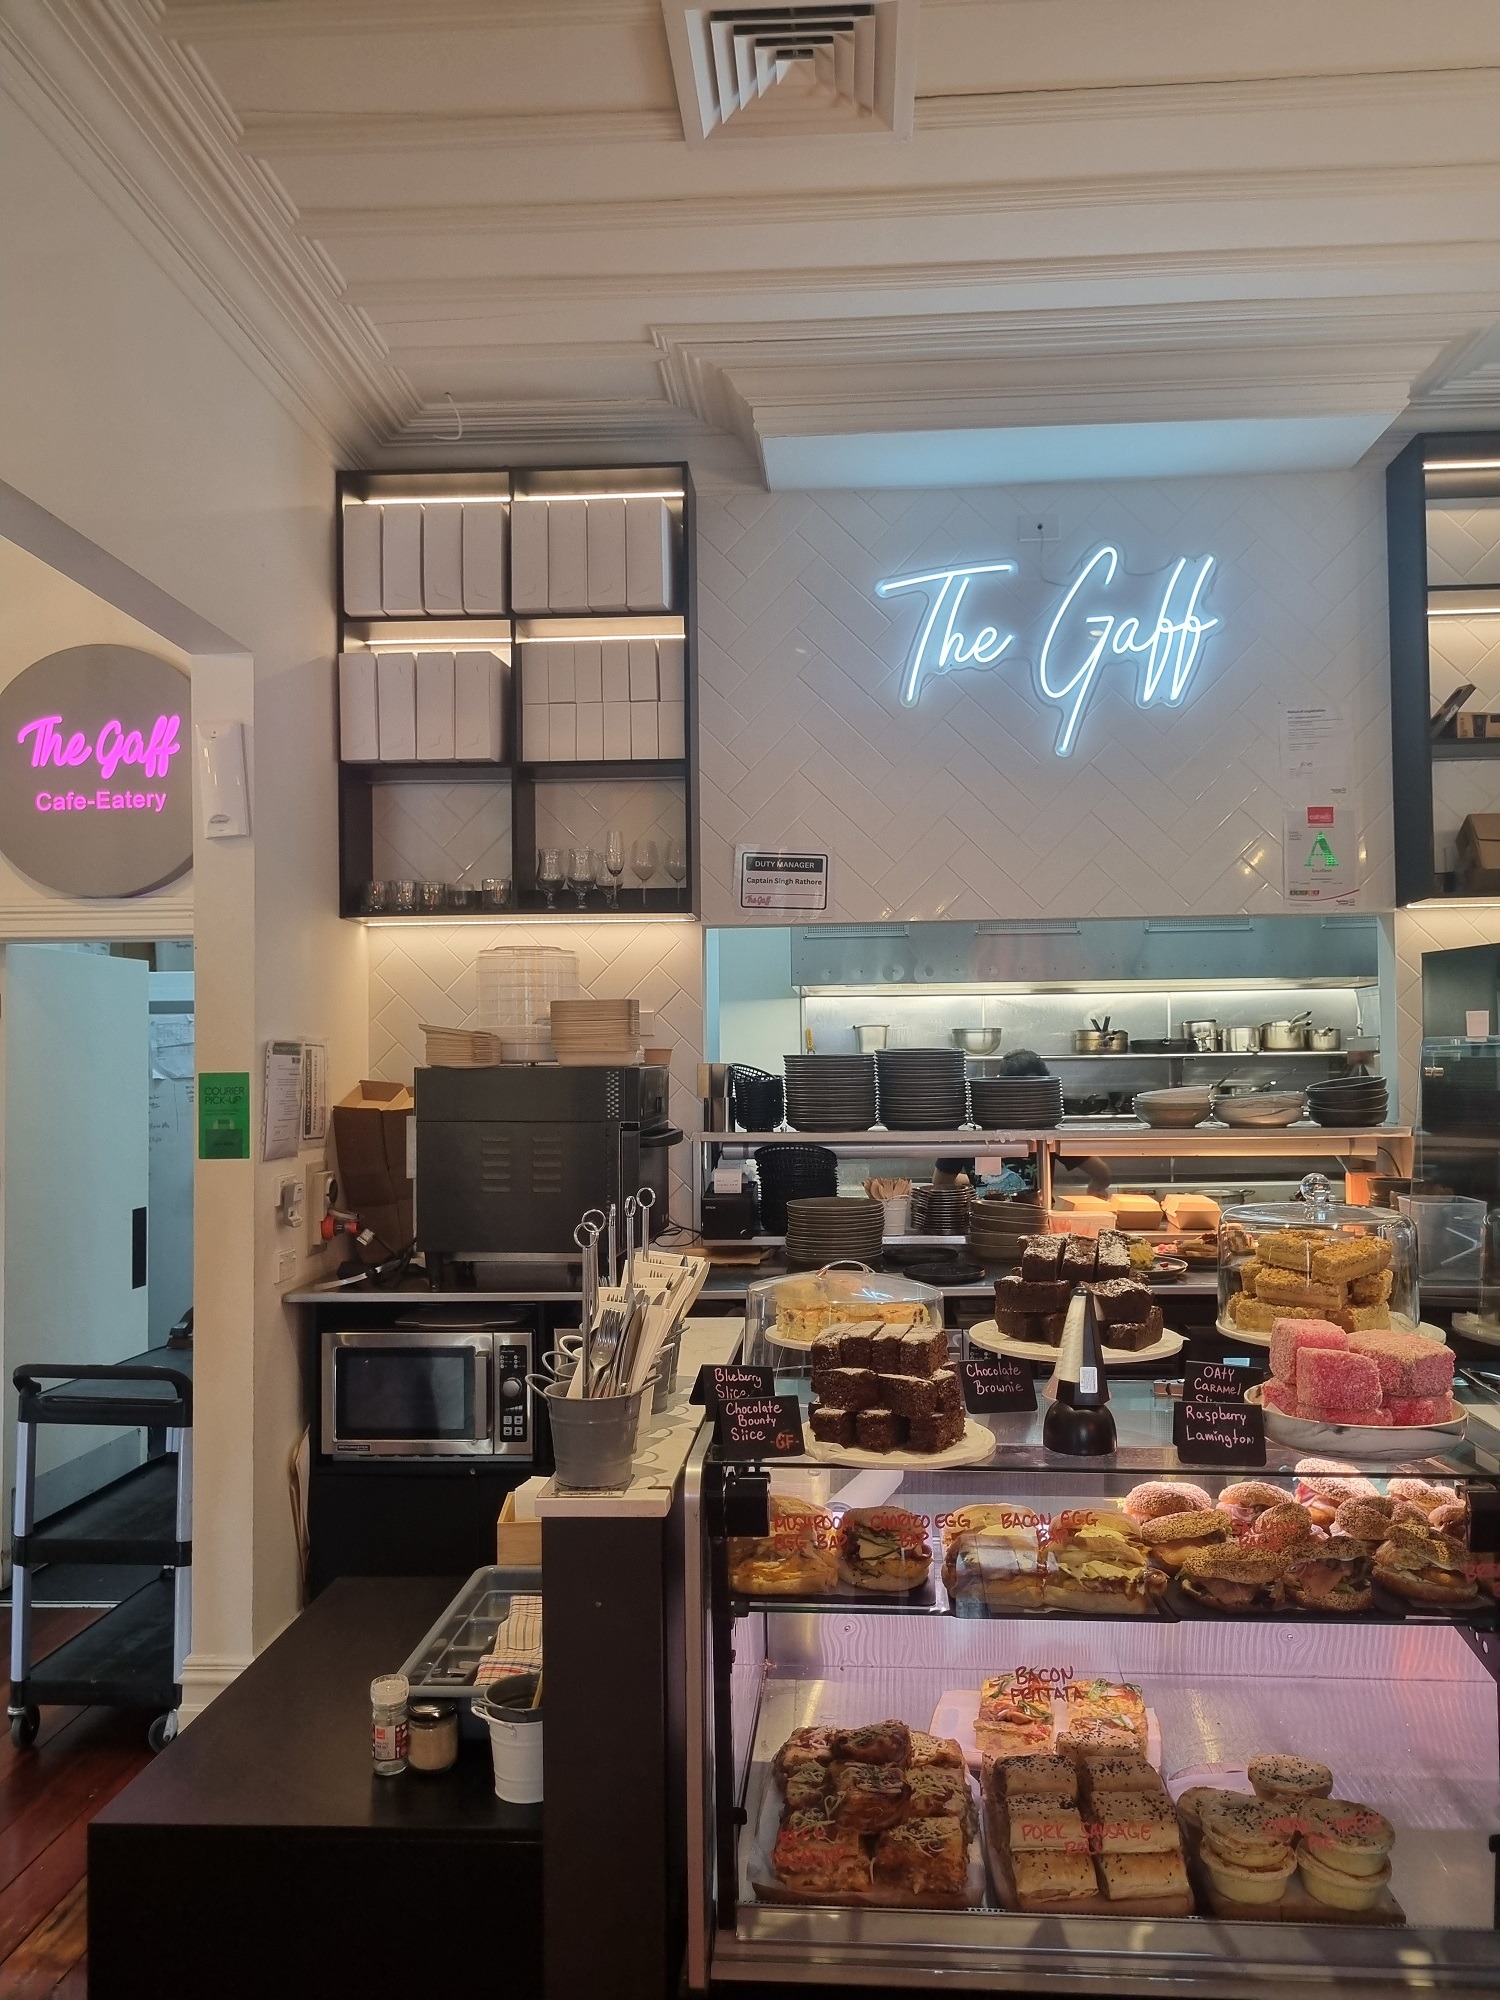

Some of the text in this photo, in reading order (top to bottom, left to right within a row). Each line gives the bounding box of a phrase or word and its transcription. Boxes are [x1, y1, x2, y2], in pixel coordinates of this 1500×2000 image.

[877, 545, 1219, 752] The Gaff
[17, 714, 182, 779] The Gaff
[36, 791, 167, 813] Cafe-Eatery
[754, 860, 815, 869] DUTY MANAGER
[746, 877, 822, 886] Captain Singh Rathore
[204, 1086, 245, 1096] COURIER
[204, 1096, 242, 1105] PICK-UP
[966, 1361, 1022, 1377] Chocolate
[973, 1379, 1024, 1395] Brownie
[725, 1400, 783, 1416] Chocolate
[1186, 1405, 1247, 1426] Raspberry
[738, 1414, 777, 1428] Bounty
[774, 1514, 855, 1532] MUSHROOM
[870, 1512, 971, 1532] CHORIZO EGG
[1000, 1509, 1099, 1530] BACON EGG
[773, 1534, 849, 1552] EGG BAP
[899, 1531, 929, 1548] BAP
[1015, 1664, 1074, 1685] BACON
[1010, 1685, 1086, 1705] FRITTATA
[1021, 1821, 1152, 1842] PORK SAUSAGE
[1063, 1840, 1103, 1855] ROLL
